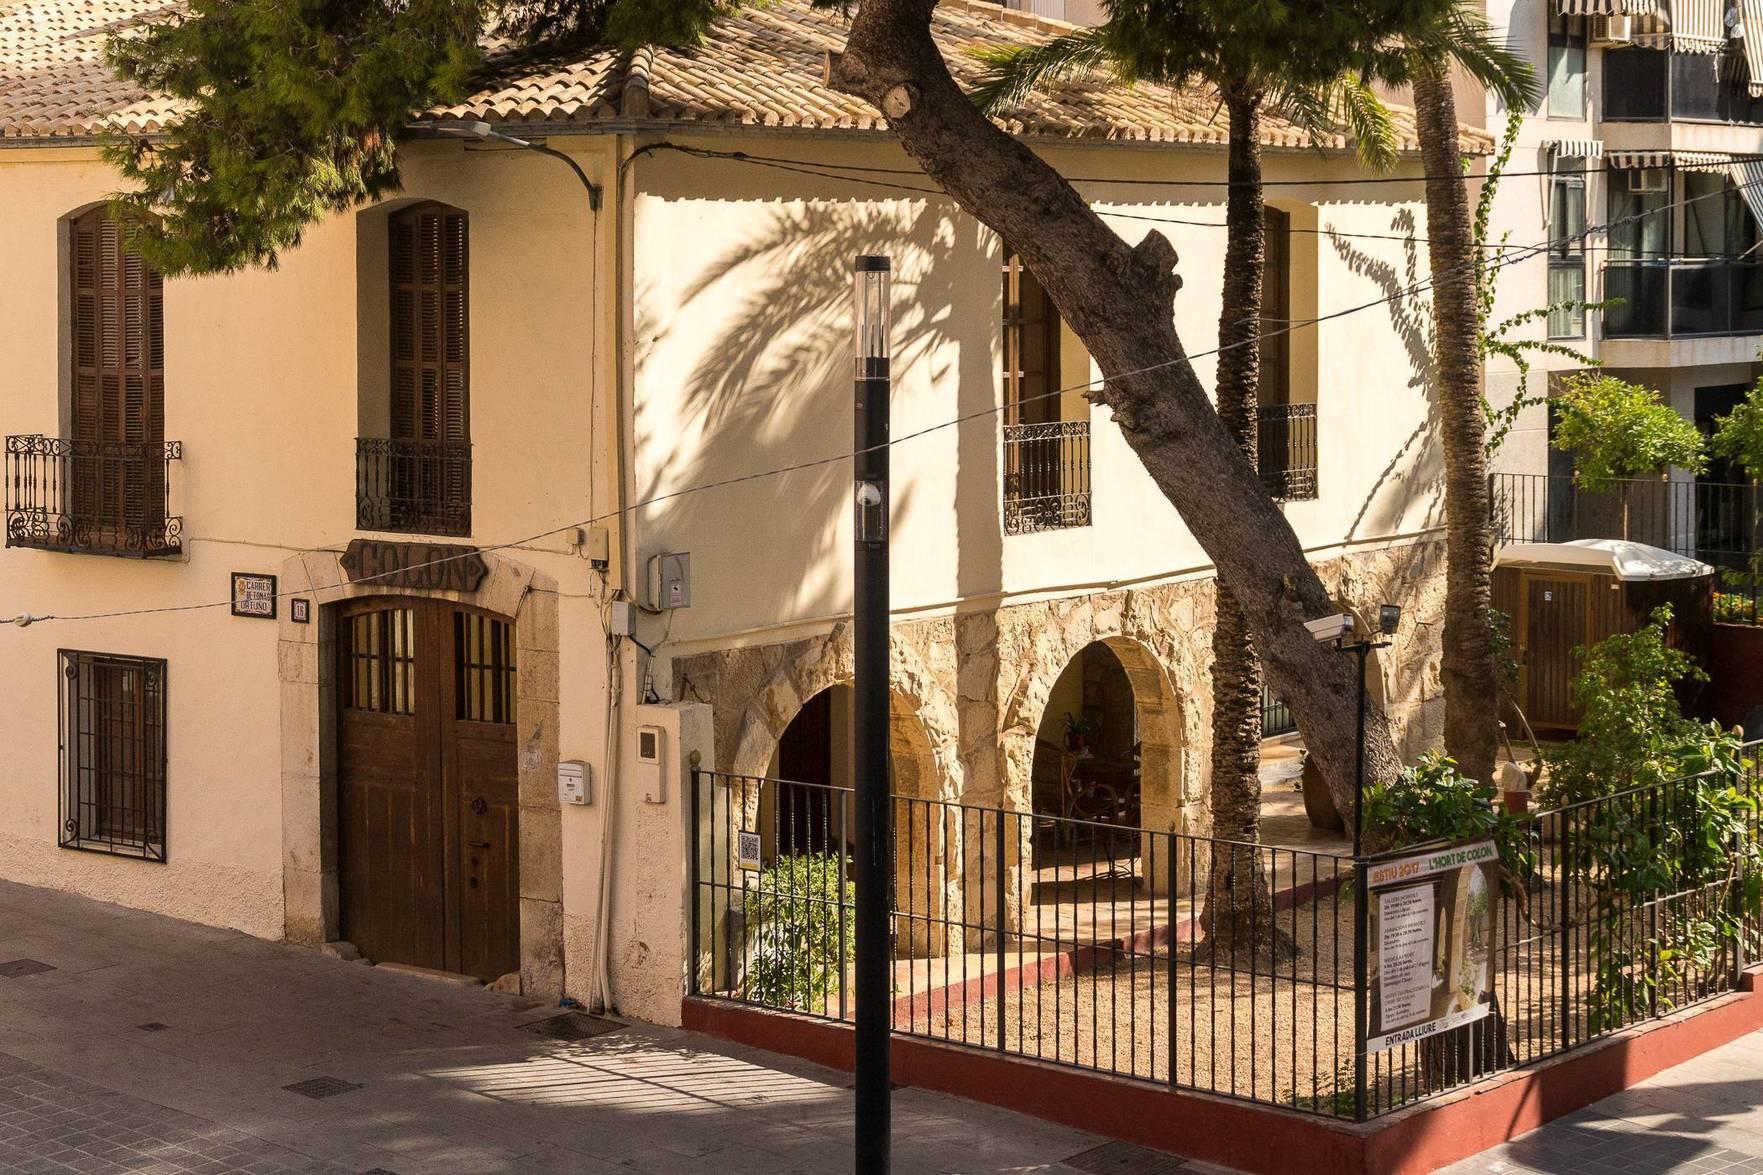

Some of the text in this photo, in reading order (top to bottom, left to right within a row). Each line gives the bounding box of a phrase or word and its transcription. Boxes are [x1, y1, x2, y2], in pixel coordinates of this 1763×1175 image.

[246, 581, 271, 591] CARRER
[246, 591, 252, 600] DE
[297, 605, 304, 617] 16
[1457, 853, 1466, 863] DE
[1467, 847, 1493, 861] COLON
[1373, 862, 1420, 882] ESTIU 2017
[1385, 1022, 1437, 1046] ENTRADA LLIURE
